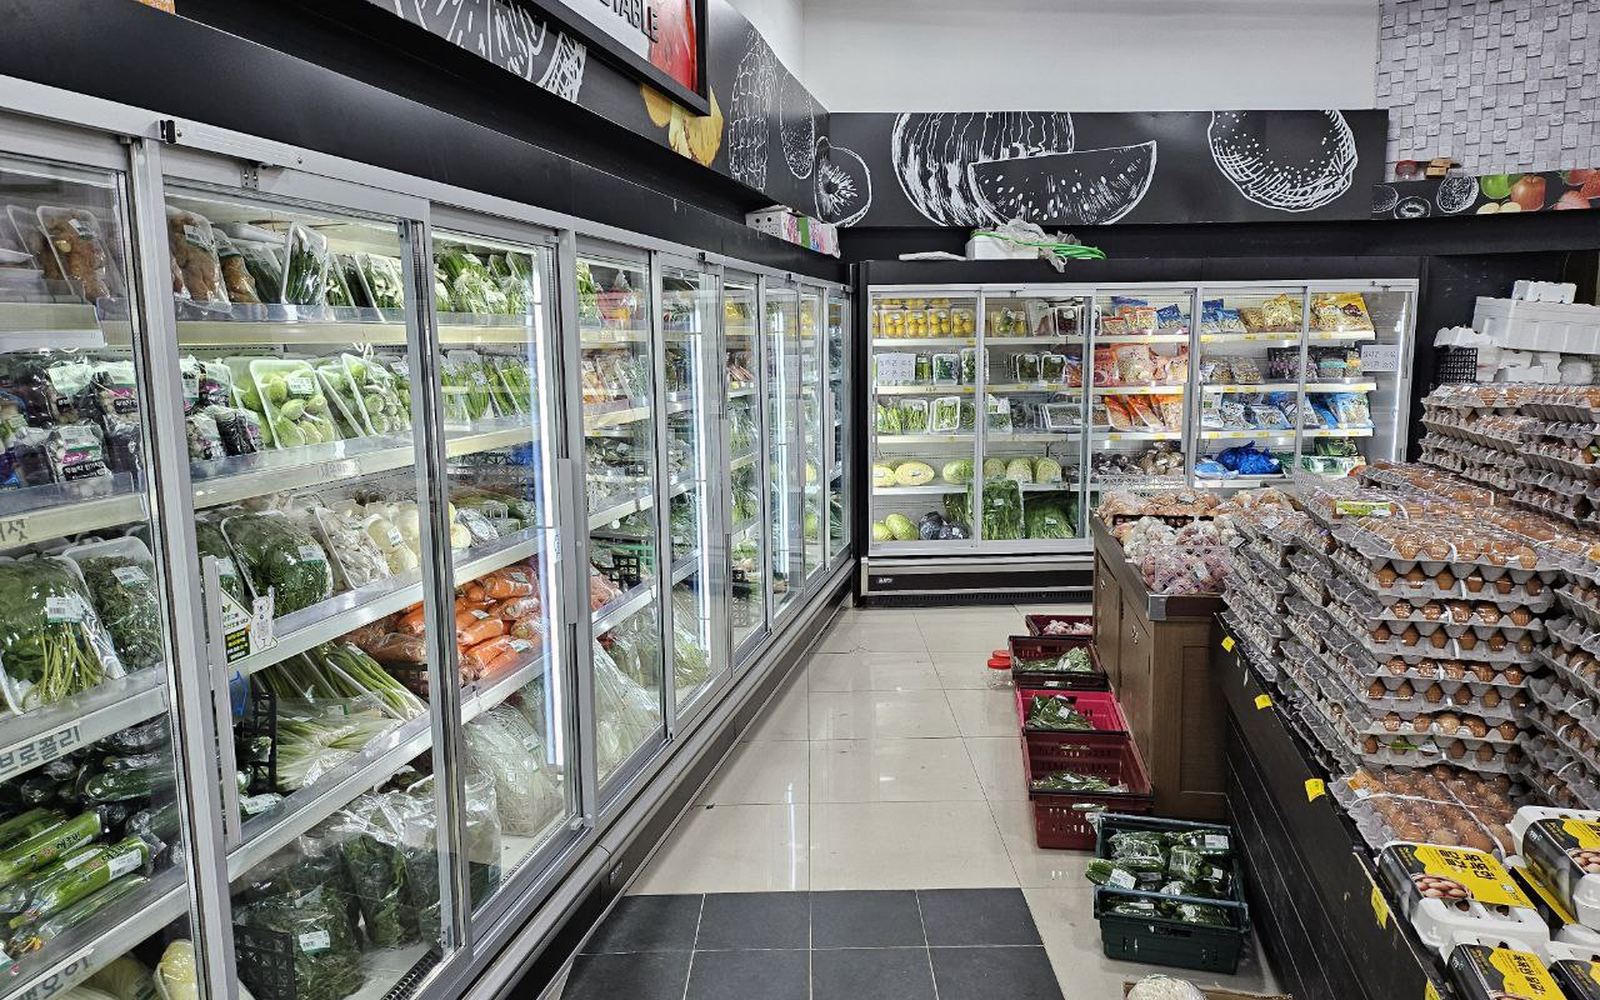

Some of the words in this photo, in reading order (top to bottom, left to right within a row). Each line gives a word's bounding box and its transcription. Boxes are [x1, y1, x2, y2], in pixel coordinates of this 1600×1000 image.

[602, 0, 659, 43] ABLE
[0, 518, 29, 542] 섯
[0, 725, 81, 775] 브로콜리
